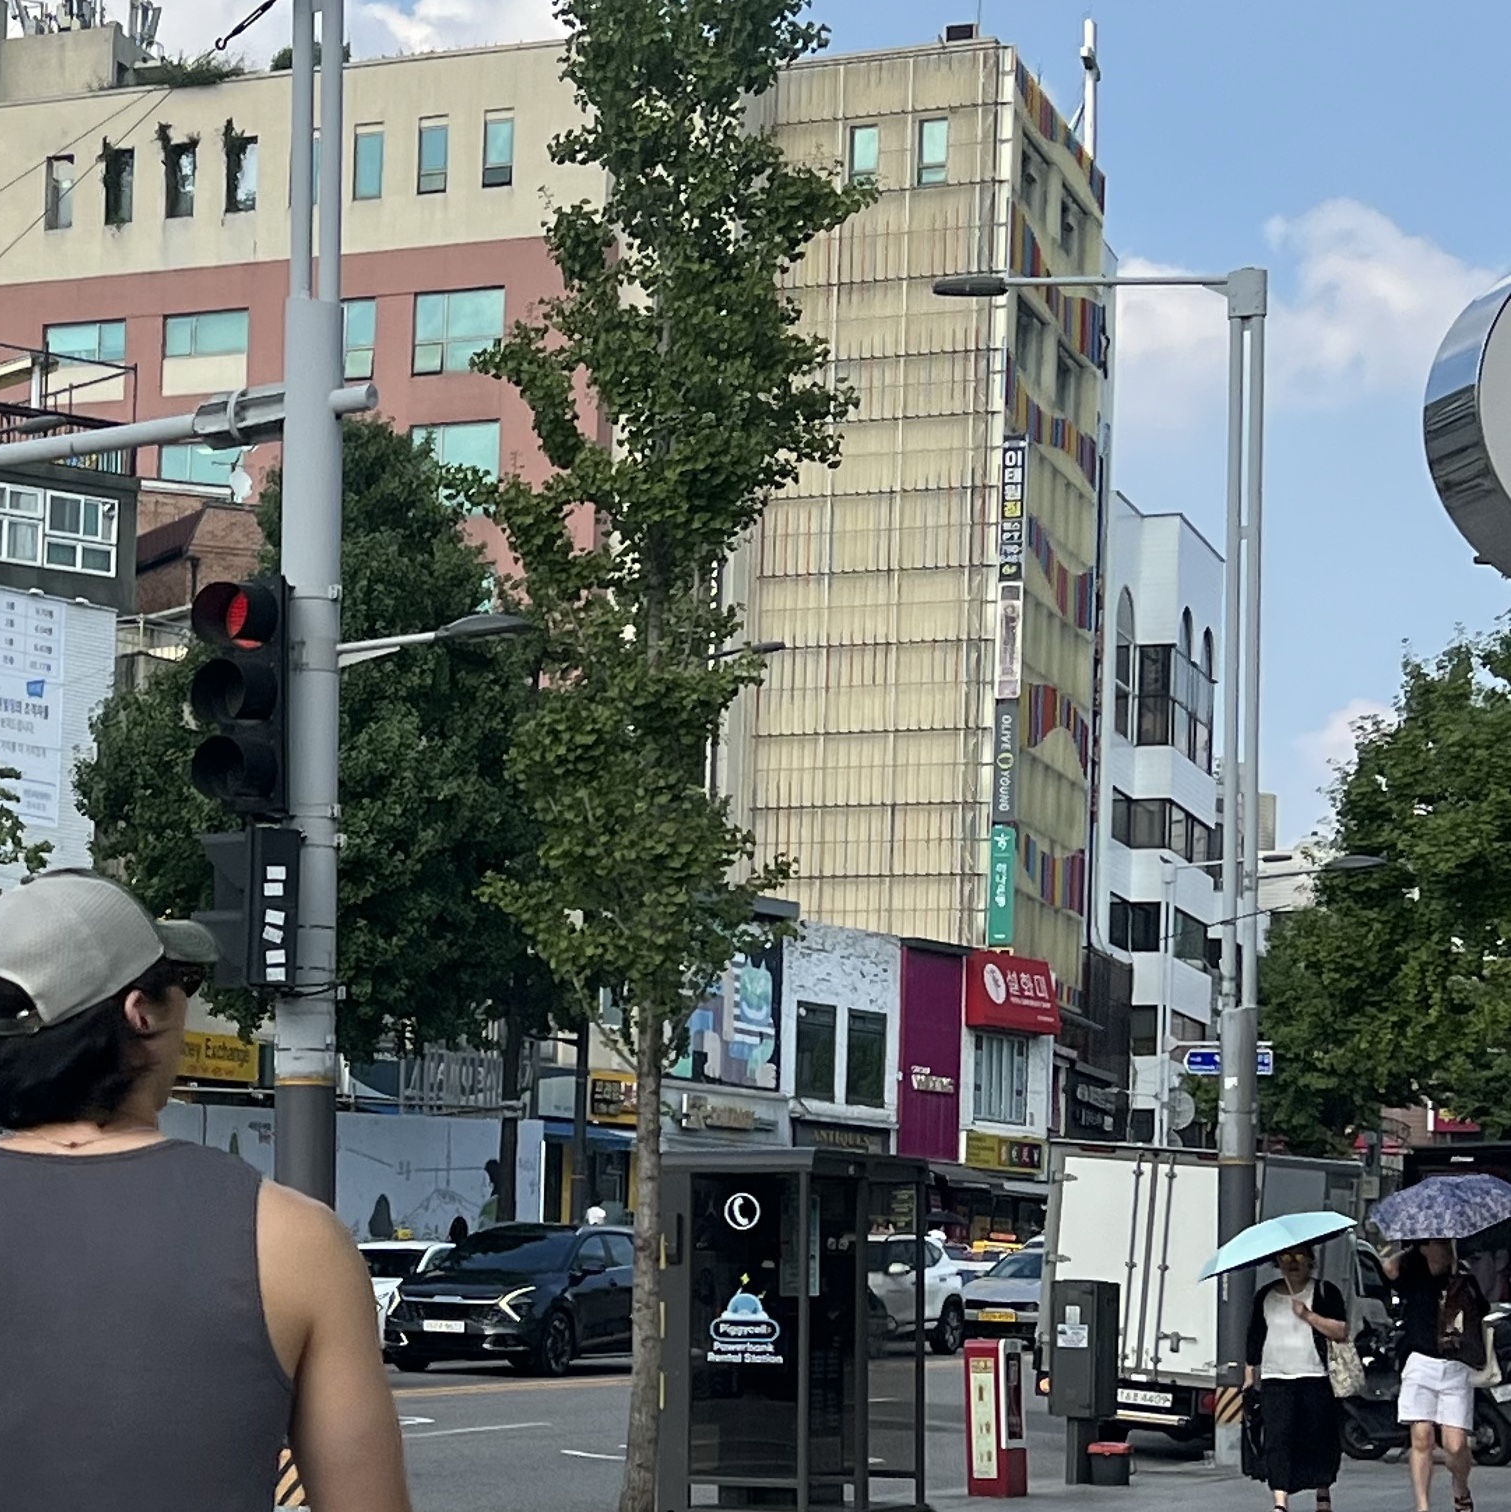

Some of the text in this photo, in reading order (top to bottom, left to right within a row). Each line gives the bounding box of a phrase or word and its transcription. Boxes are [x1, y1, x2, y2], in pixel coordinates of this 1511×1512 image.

[998, 715, 1013, 812] OLIVE YOUNG
[205, 1037, 250, 1068] Exchange
[812, 1129, 870, 1147] ANTIQUES
[713, 1341, 774, 1353] Powerbank
[707, 1352, 783, 1364] Rental Station
